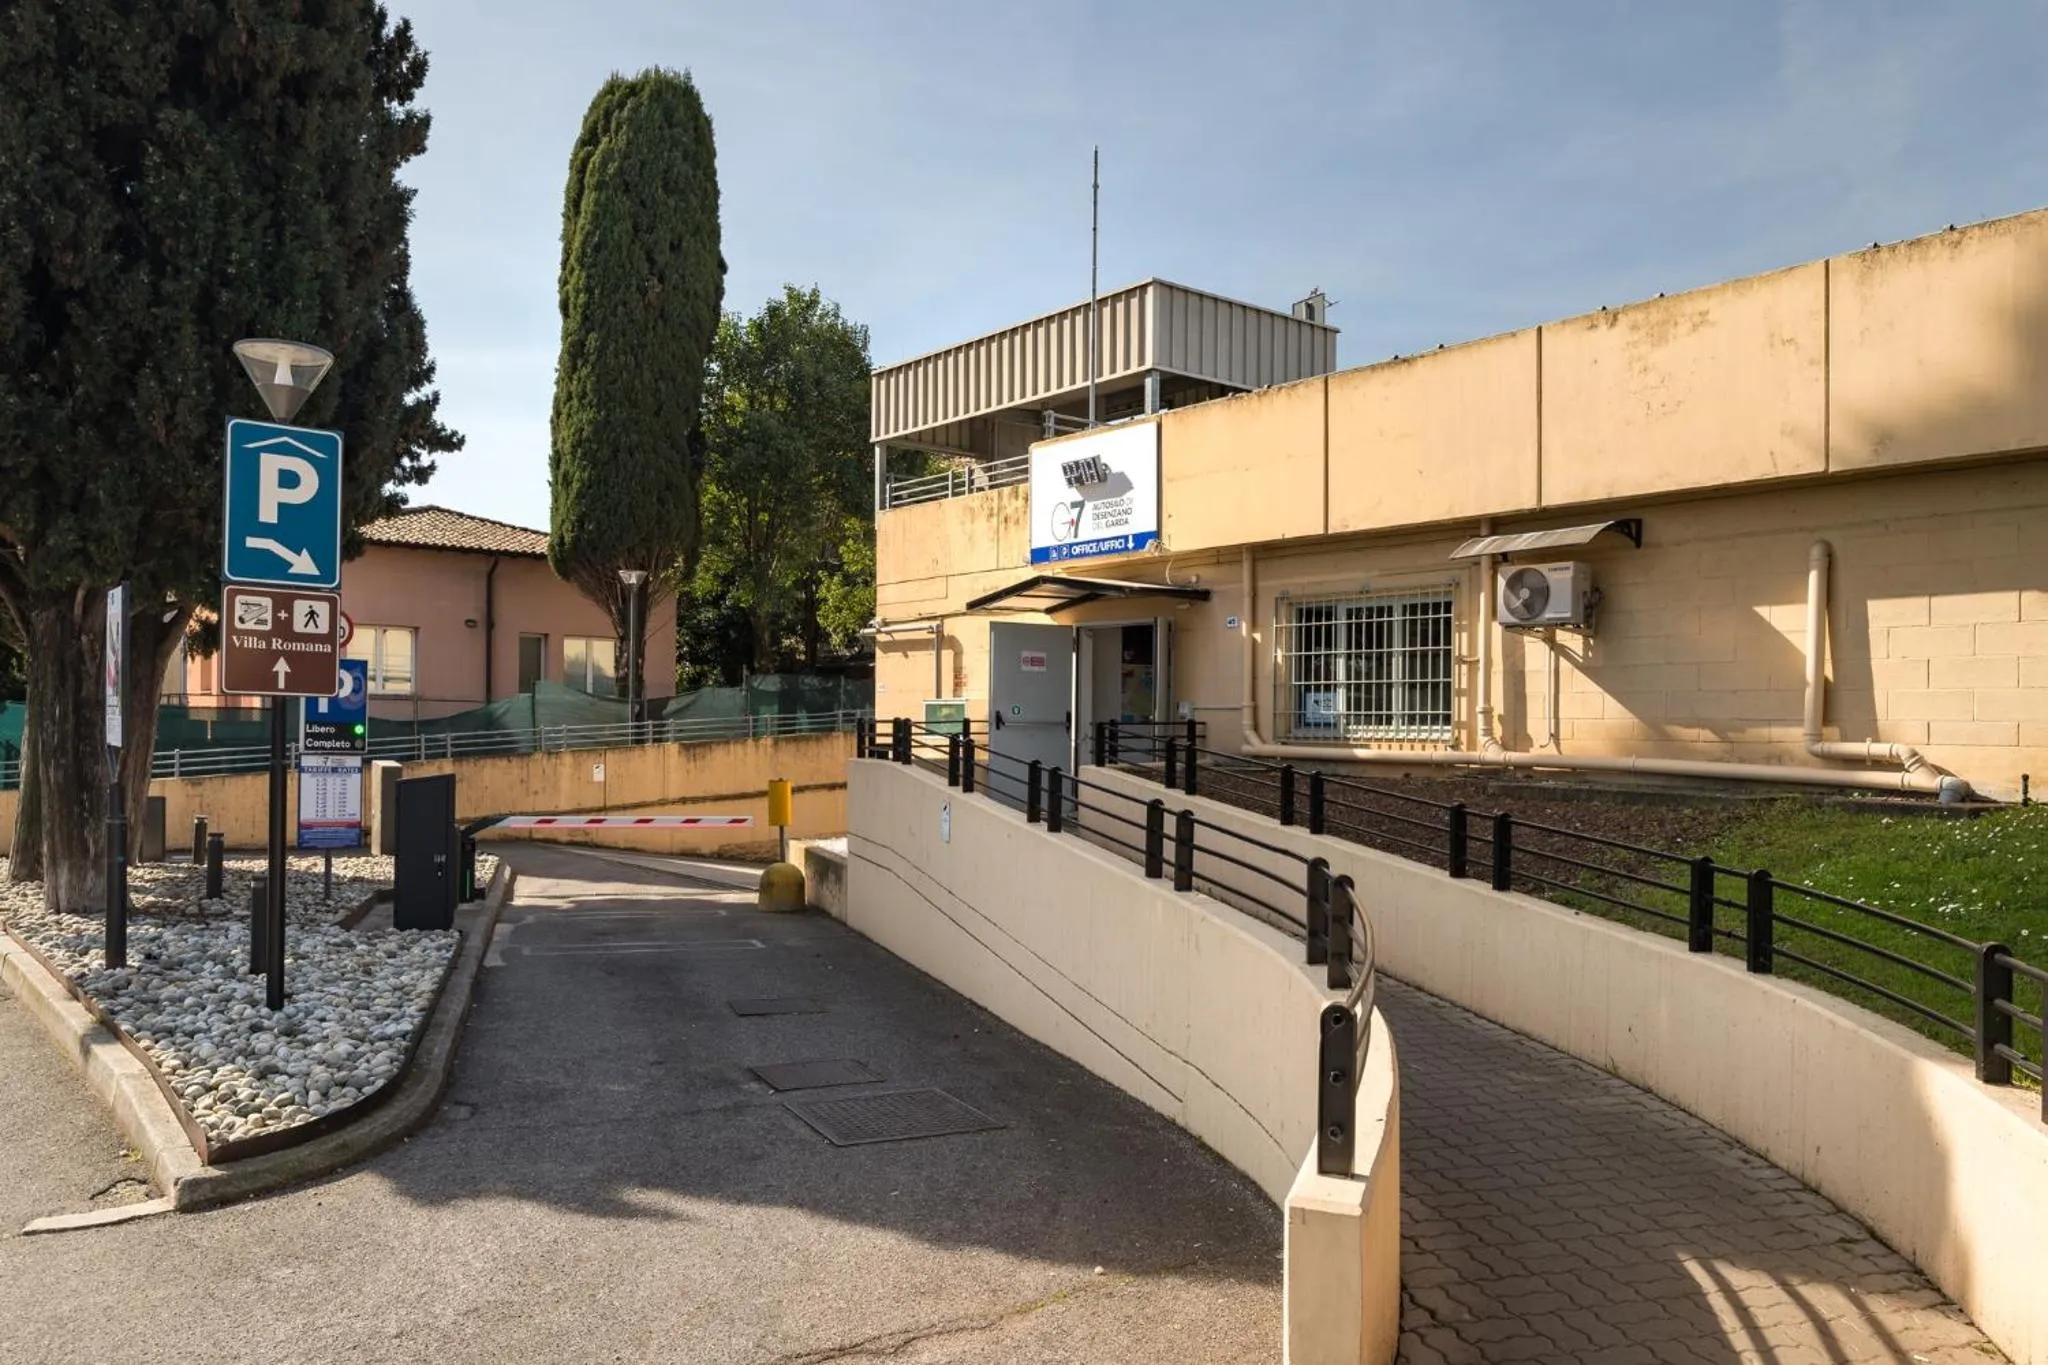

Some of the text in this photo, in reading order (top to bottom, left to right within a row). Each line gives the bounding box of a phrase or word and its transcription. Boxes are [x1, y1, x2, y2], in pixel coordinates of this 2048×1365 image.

[258, 452, 320, 524] P
[1092, 508, 1133, 521] DESENZANO
[1105, 517, 1130, 528] GARDA
[232, 635, 332, 653] Villa Romana
[306, 723, 336, 733] Libero
[305, 738, 352, 748] Completo
